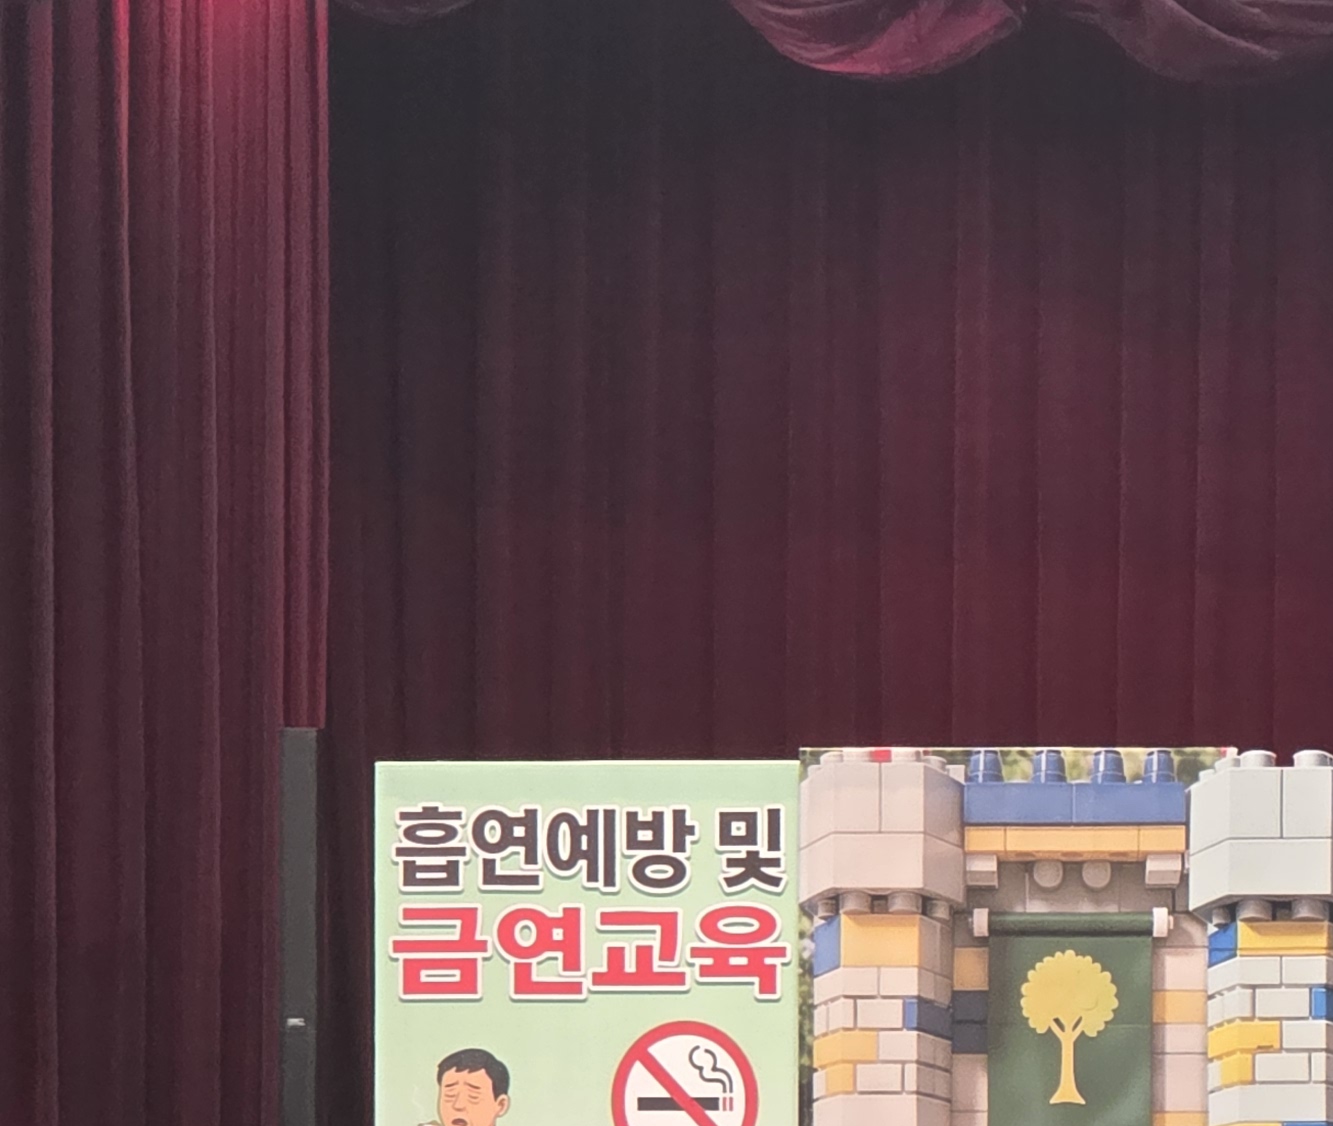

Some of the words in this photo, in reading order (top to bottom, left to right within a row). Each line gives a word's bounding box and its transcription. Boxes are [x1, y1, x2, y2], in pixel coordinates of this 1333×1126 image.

[395, 806, 695, 889] 흡연예방
[718, 807, 787, 889] 및
[392, 906, 788, 995] 금연교육
